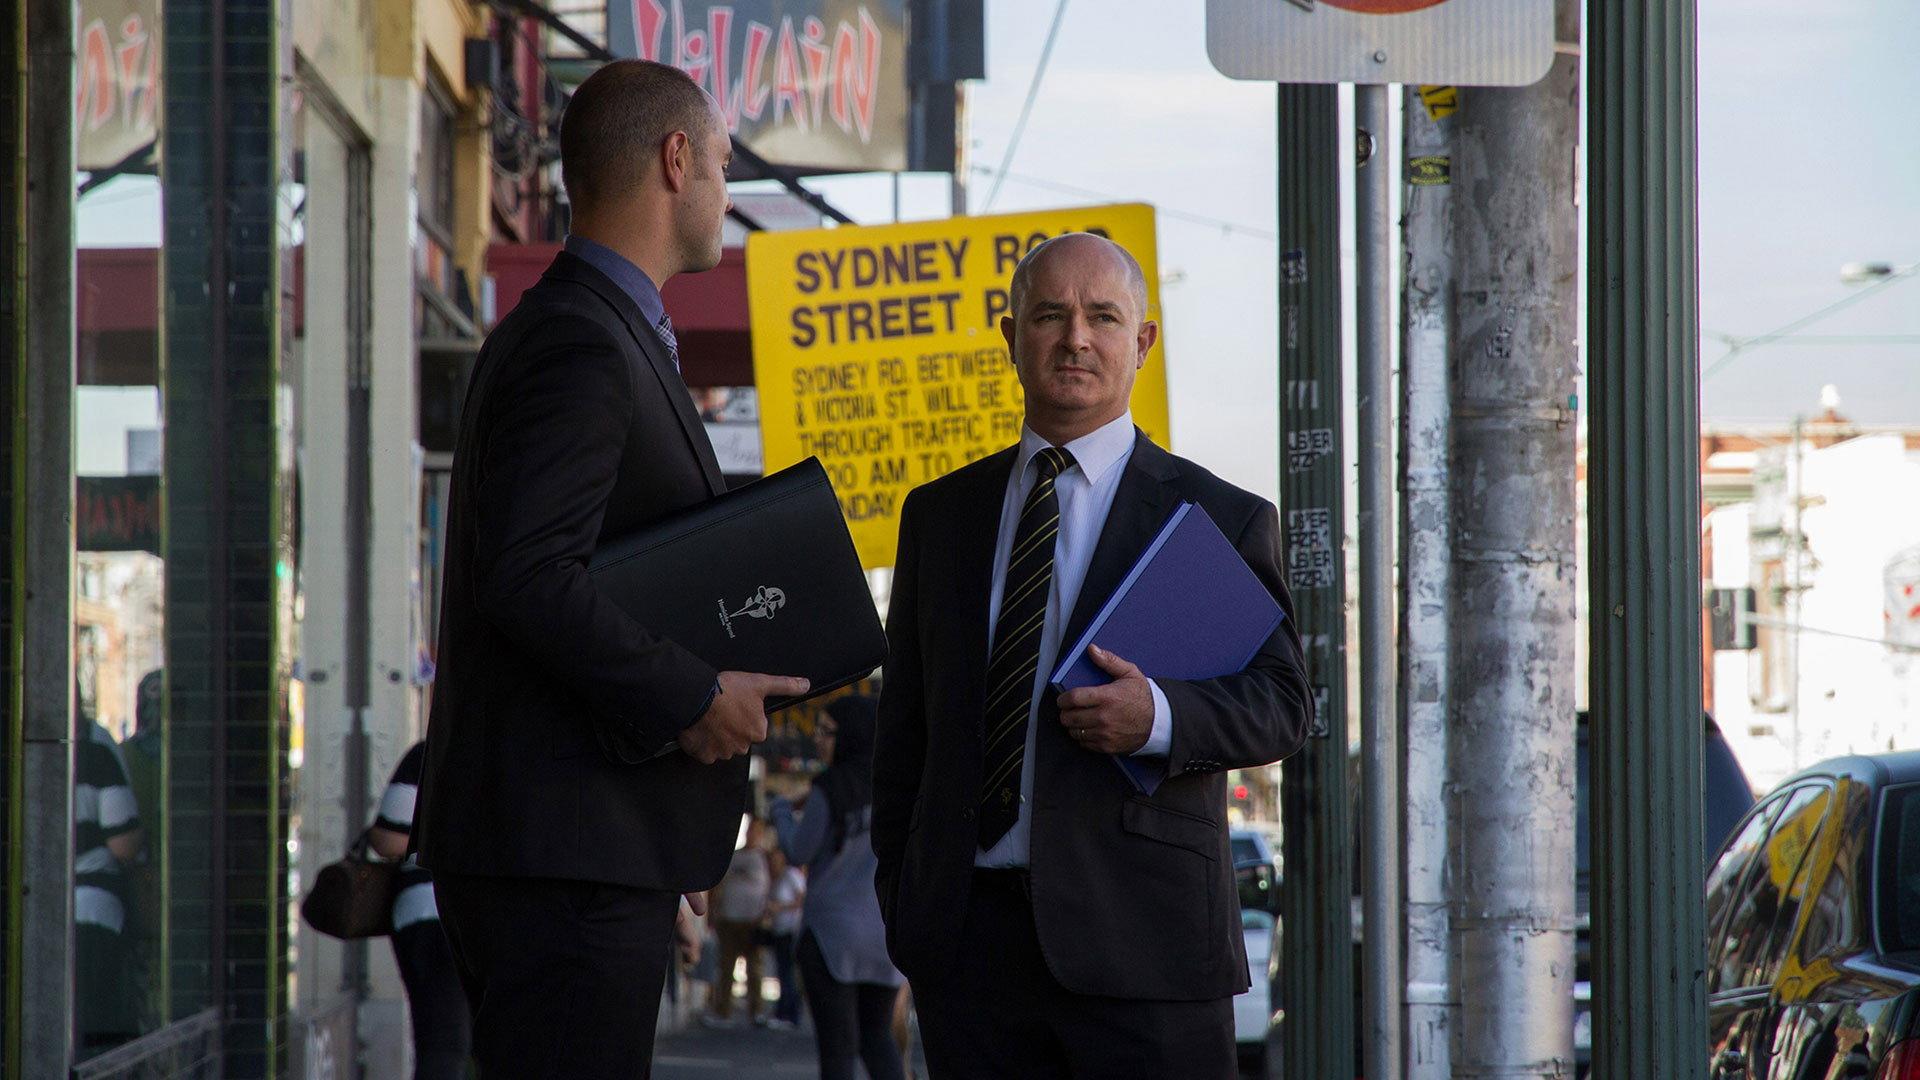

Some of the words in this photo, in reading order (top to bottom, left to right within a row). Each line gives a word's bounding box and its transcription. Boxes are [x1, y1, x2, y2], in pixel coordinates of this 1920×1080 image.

[796, 236, 970, 293] SYDNEY
[791, 292, 961, 348] STREET
[792, 361, 869, 396] SYDNEY
[815, 392, 878, 422] VICTORIA
[923, 385, 971, 412] WILL
[976, 379, 1003, 408] BE
[797, 422, 894, 459] THROUGH
[901, 414, 984, 448] TRAFFIC
[869, 456, 908, 487] AM
[919, 451, 953, 478] TO
